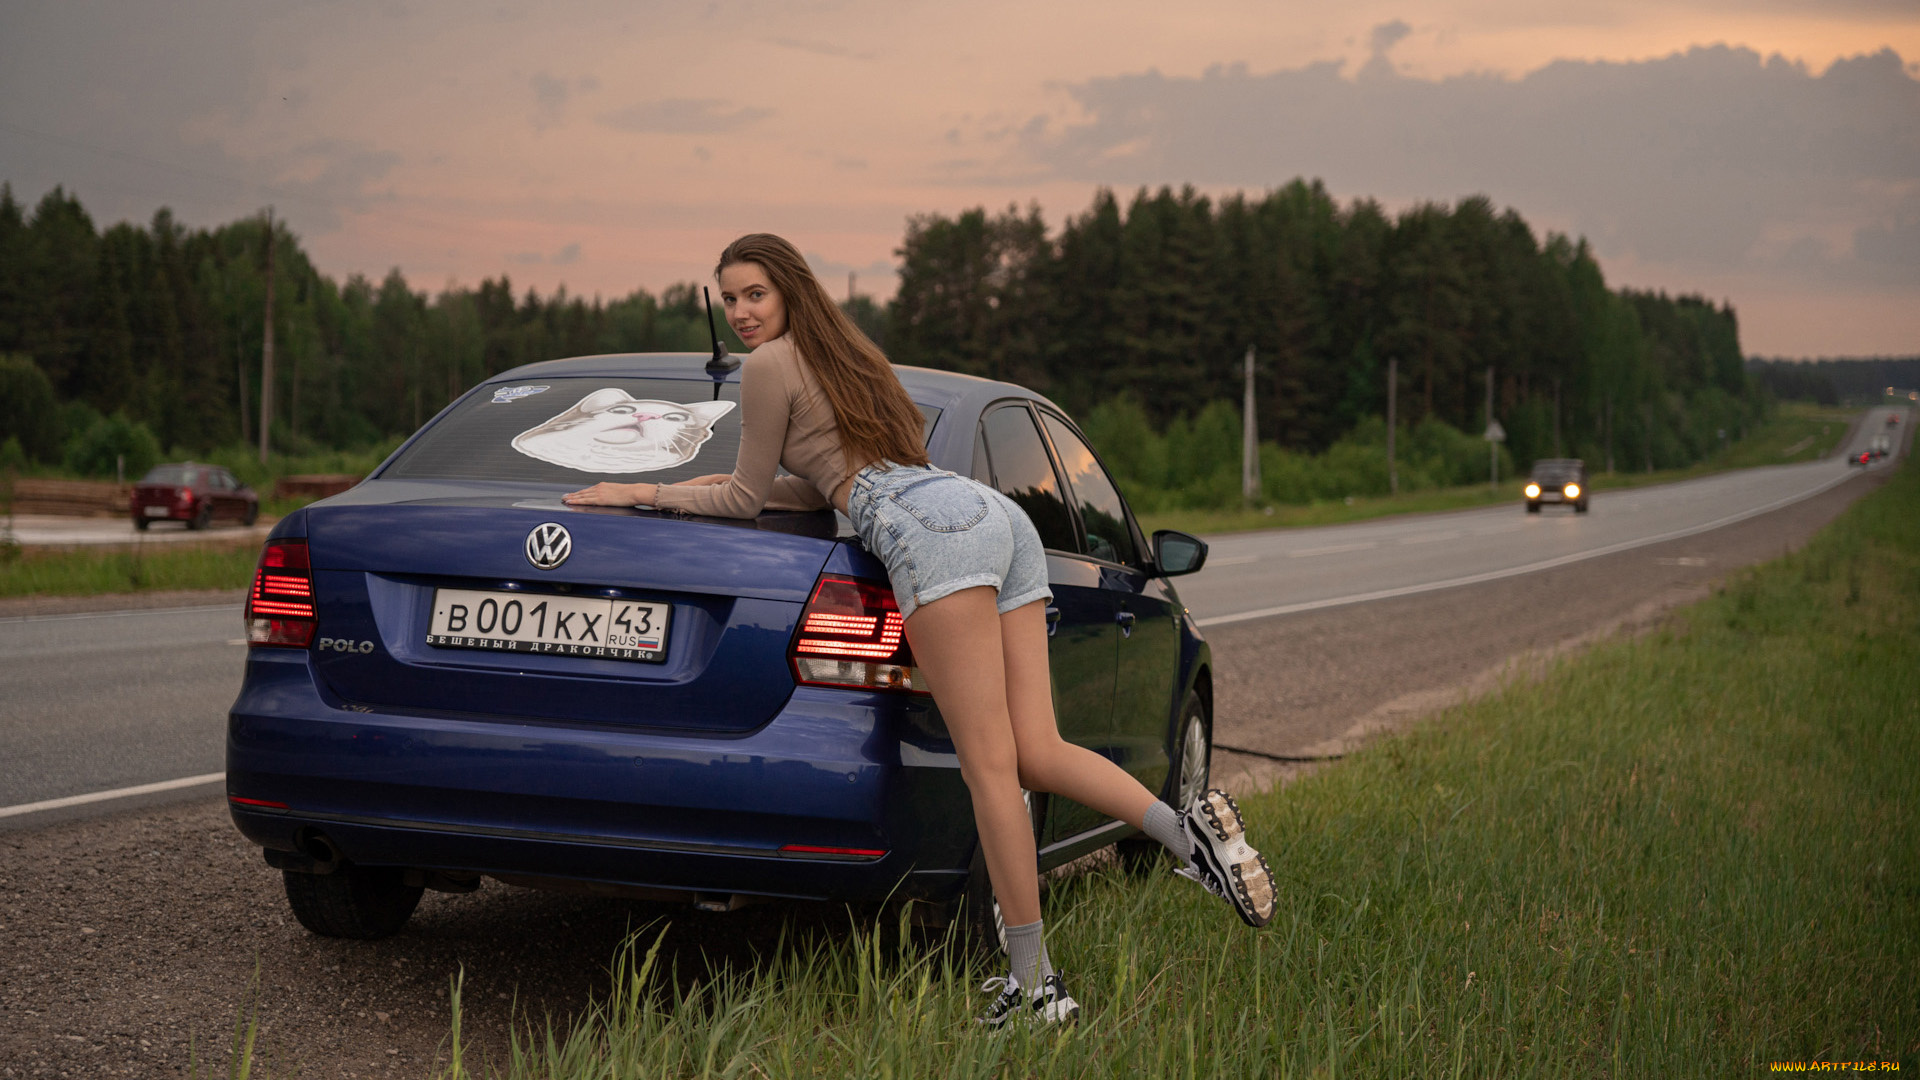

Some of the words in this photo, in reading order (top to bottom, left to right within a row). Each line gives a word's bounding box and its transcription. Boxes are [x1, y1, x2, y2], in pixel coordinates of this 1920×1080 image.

[527, 523, 571, 569] VW
[615, 605, 653, 634] 43
[319, 637, 375, 654] POLO
[426, 634, 517, 649] БЕШЕНЫЙ
[530, 643, 646, 659] ДРАКОНЧИК
[609, 634, 636, 647] RUS
